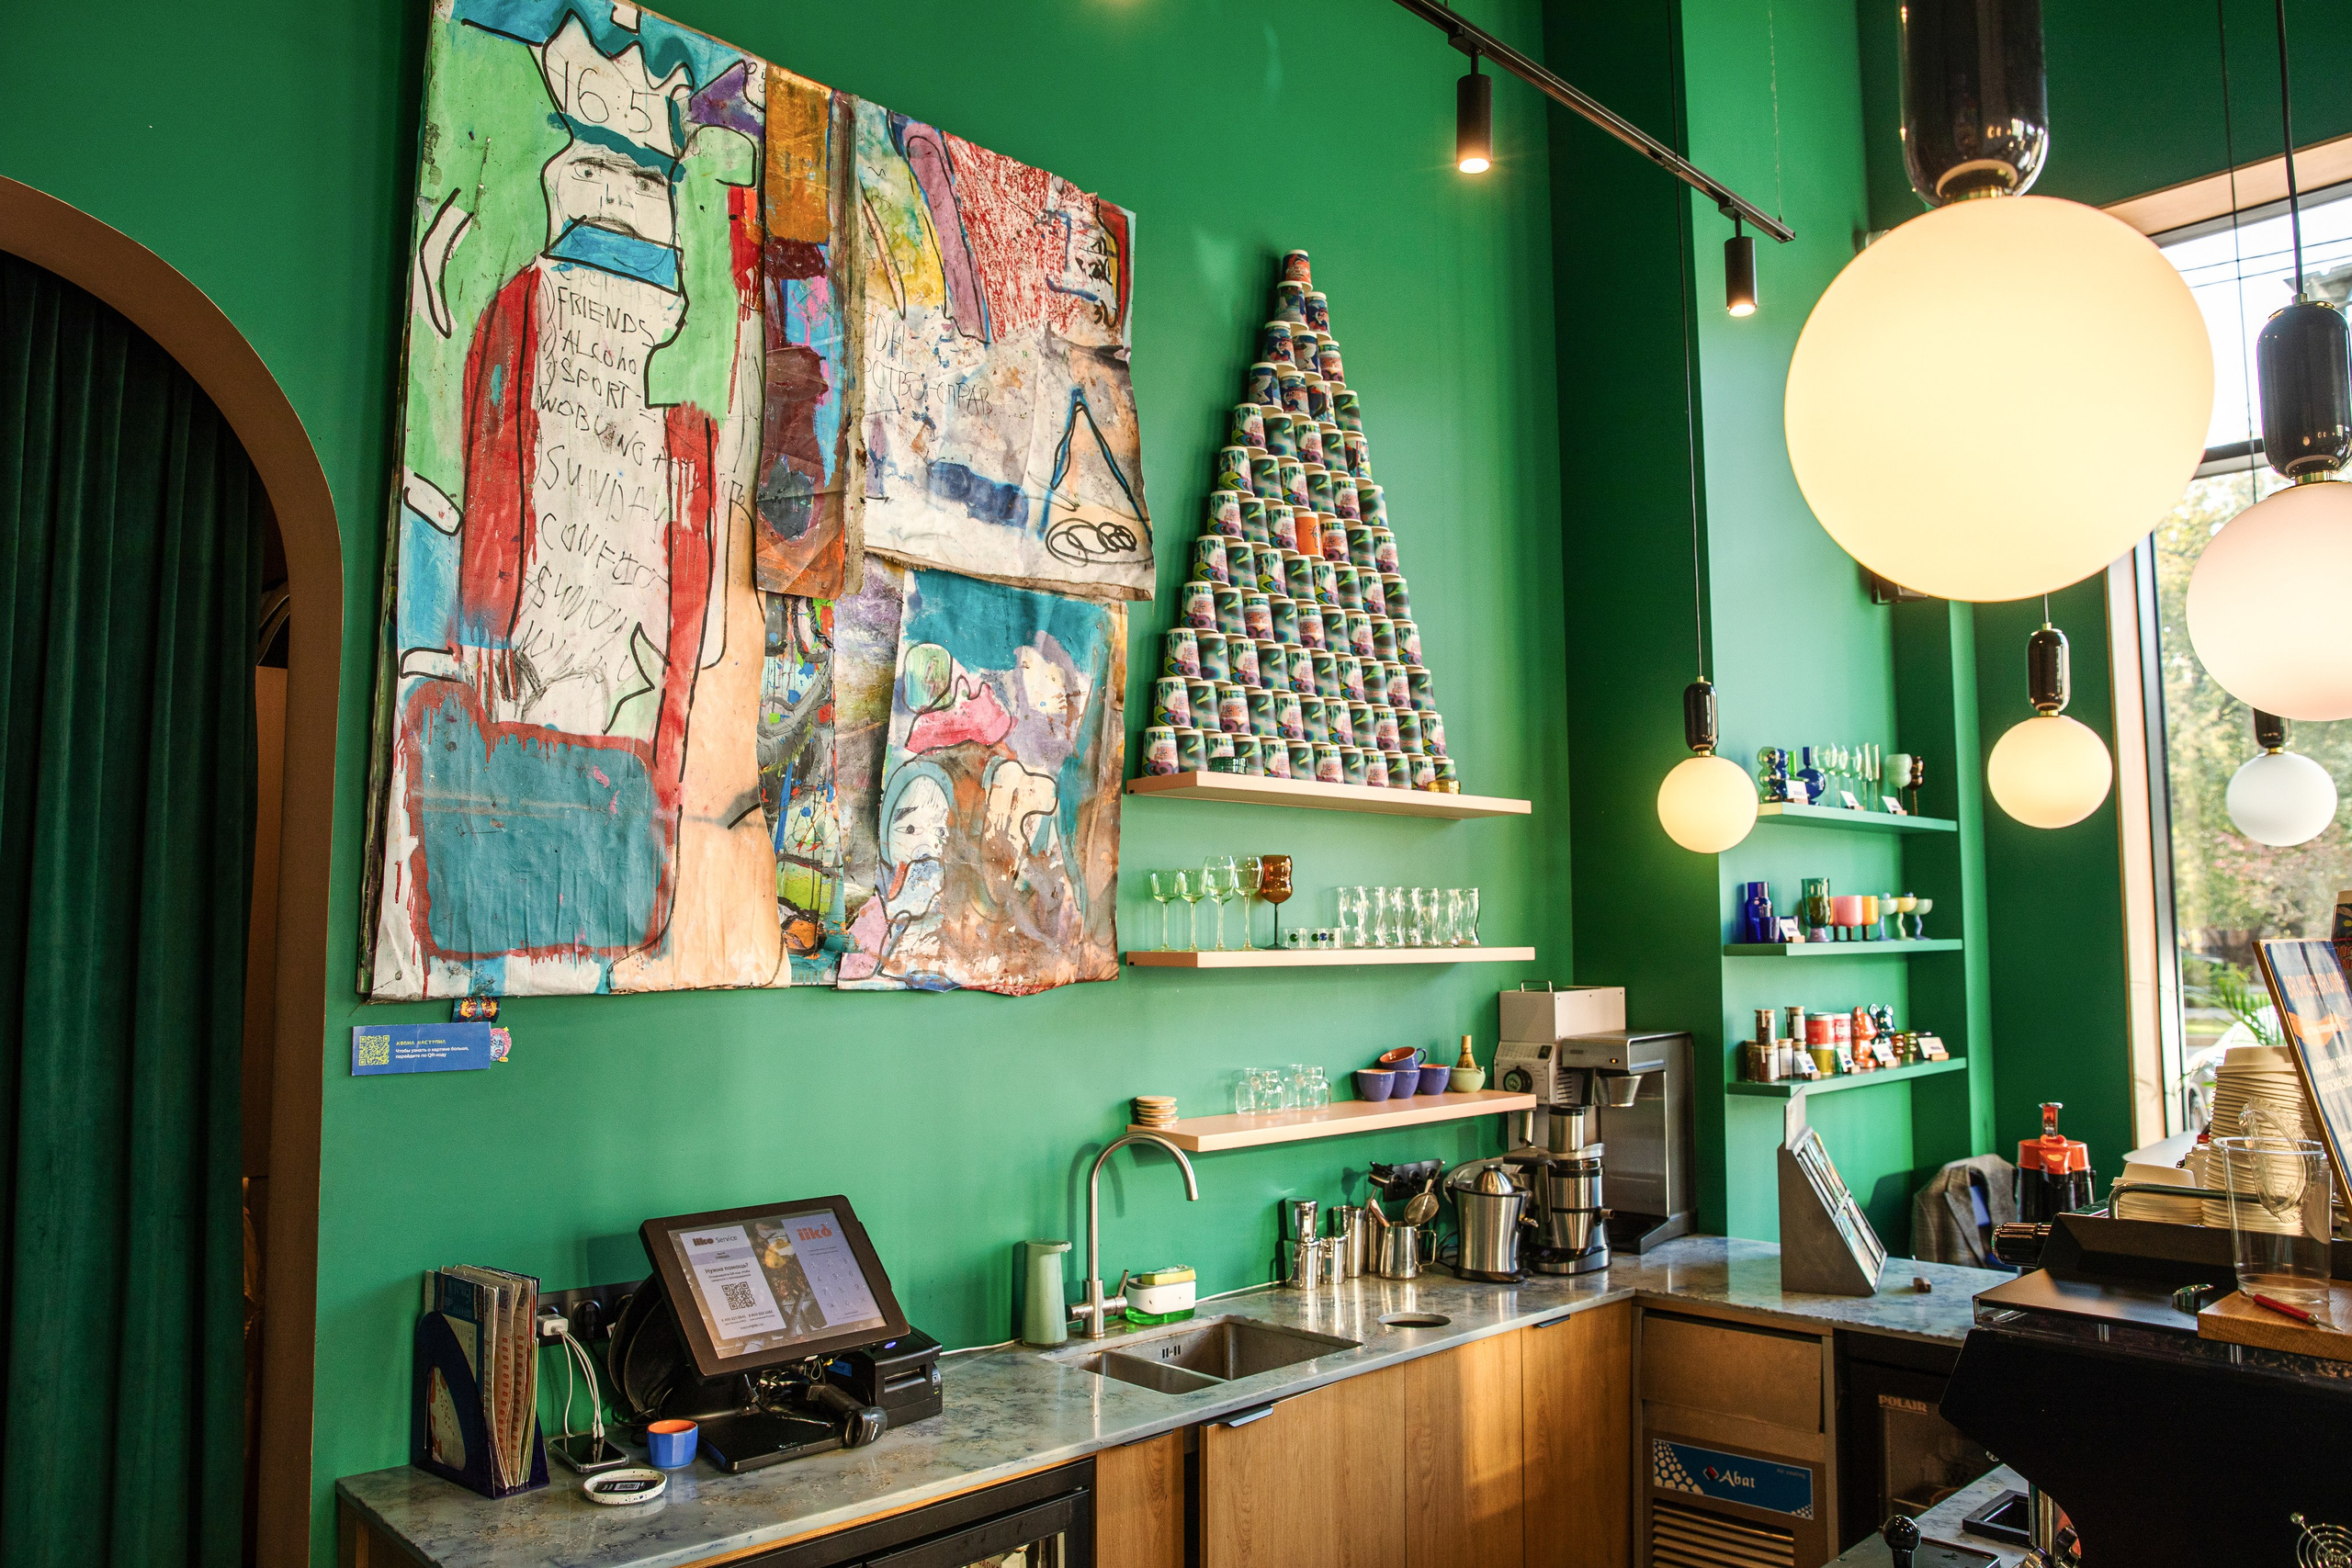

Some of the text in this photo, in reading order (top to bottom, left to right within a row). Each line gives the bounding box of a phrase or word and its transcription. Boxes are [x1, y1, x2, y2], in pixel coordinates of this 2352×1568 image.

[558, 286, 656, 348] FRIENDS
[560, 356, 641, 409] SPORT
[715, 1235, 739, 1244] Service
[724, 1263, 749, 1271] помощь?
[1878, 1394, 1928, 1413] POLAIR
